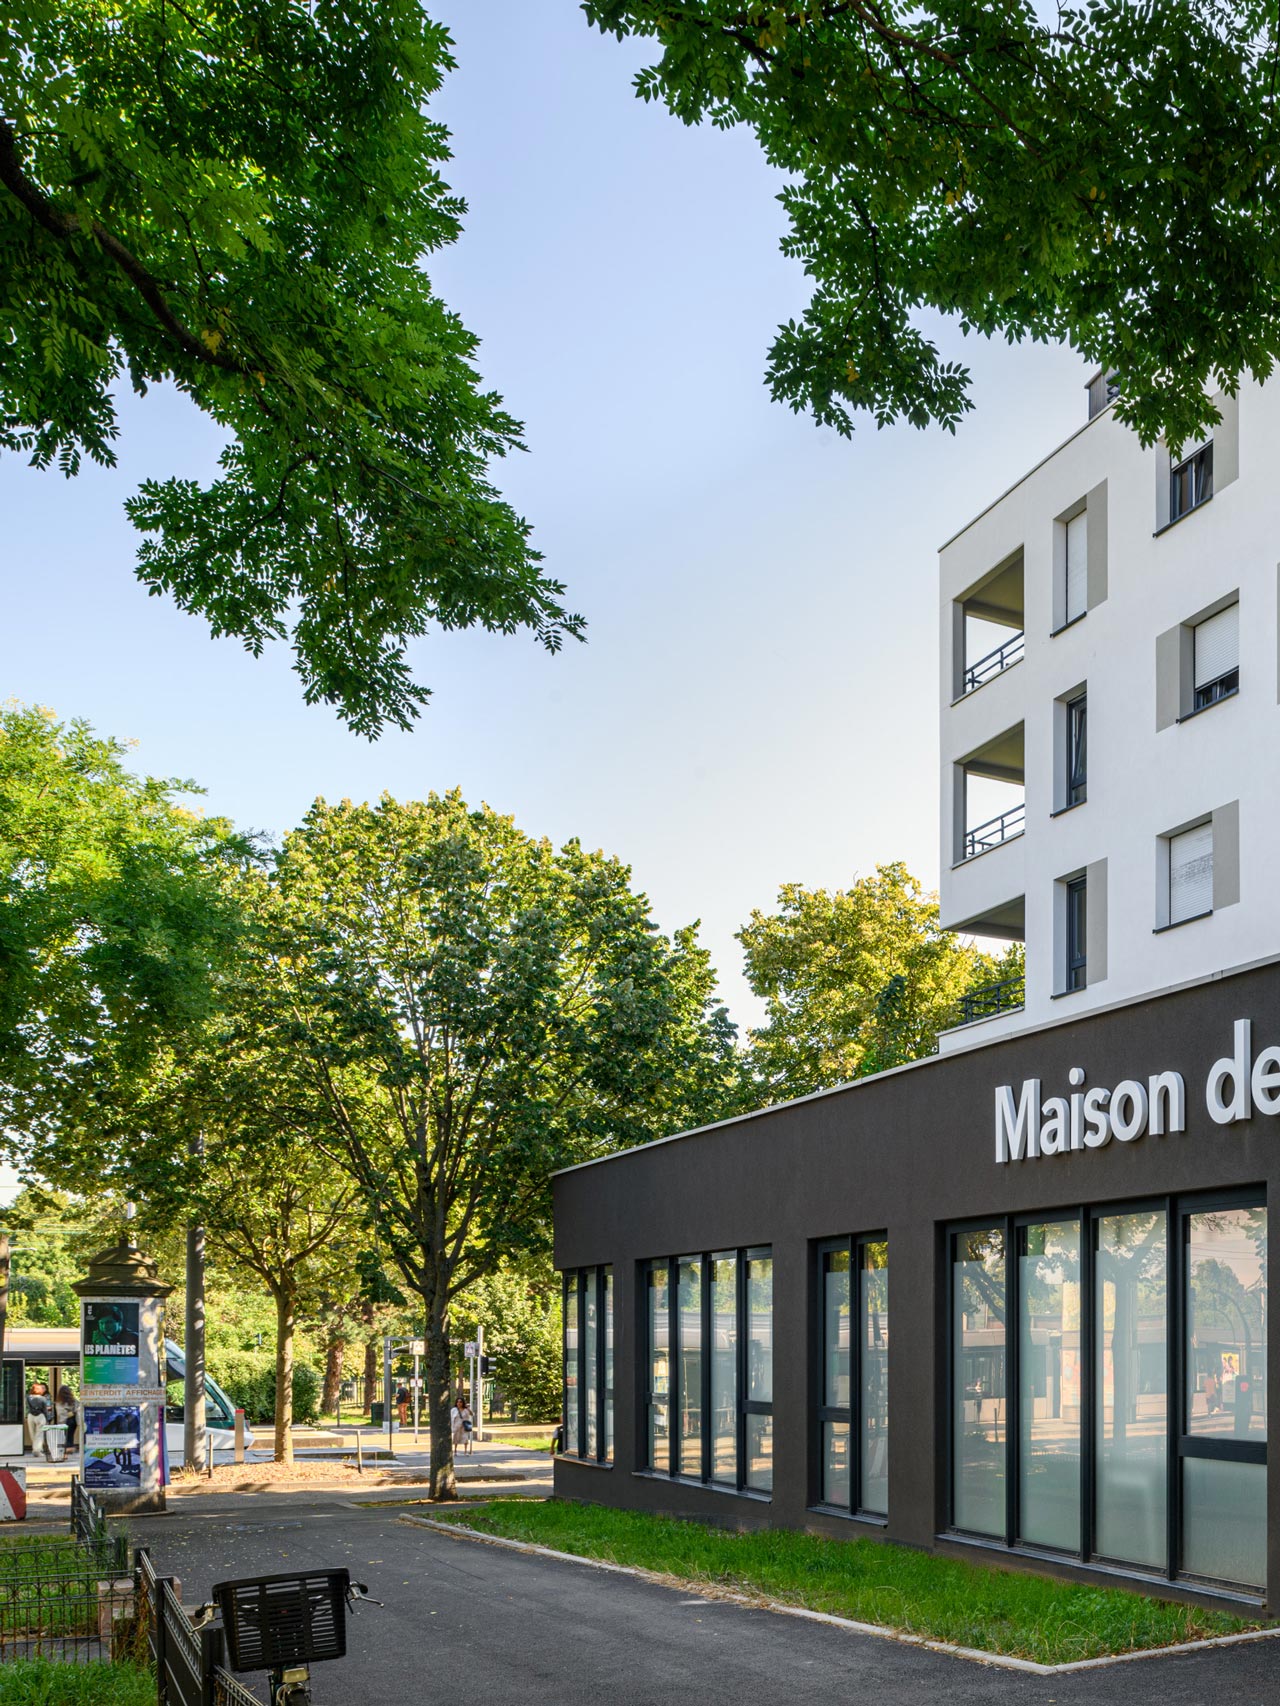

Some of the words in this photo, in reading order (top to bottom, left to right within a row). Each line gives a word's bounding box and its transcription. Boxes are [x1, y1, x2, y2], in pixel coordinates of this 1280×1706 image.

[994, 1067, 1185, 1163] Maison
[84, 1344, 94, 1355] LES
[95, 1342, 136, 1355] PLANÈTES
